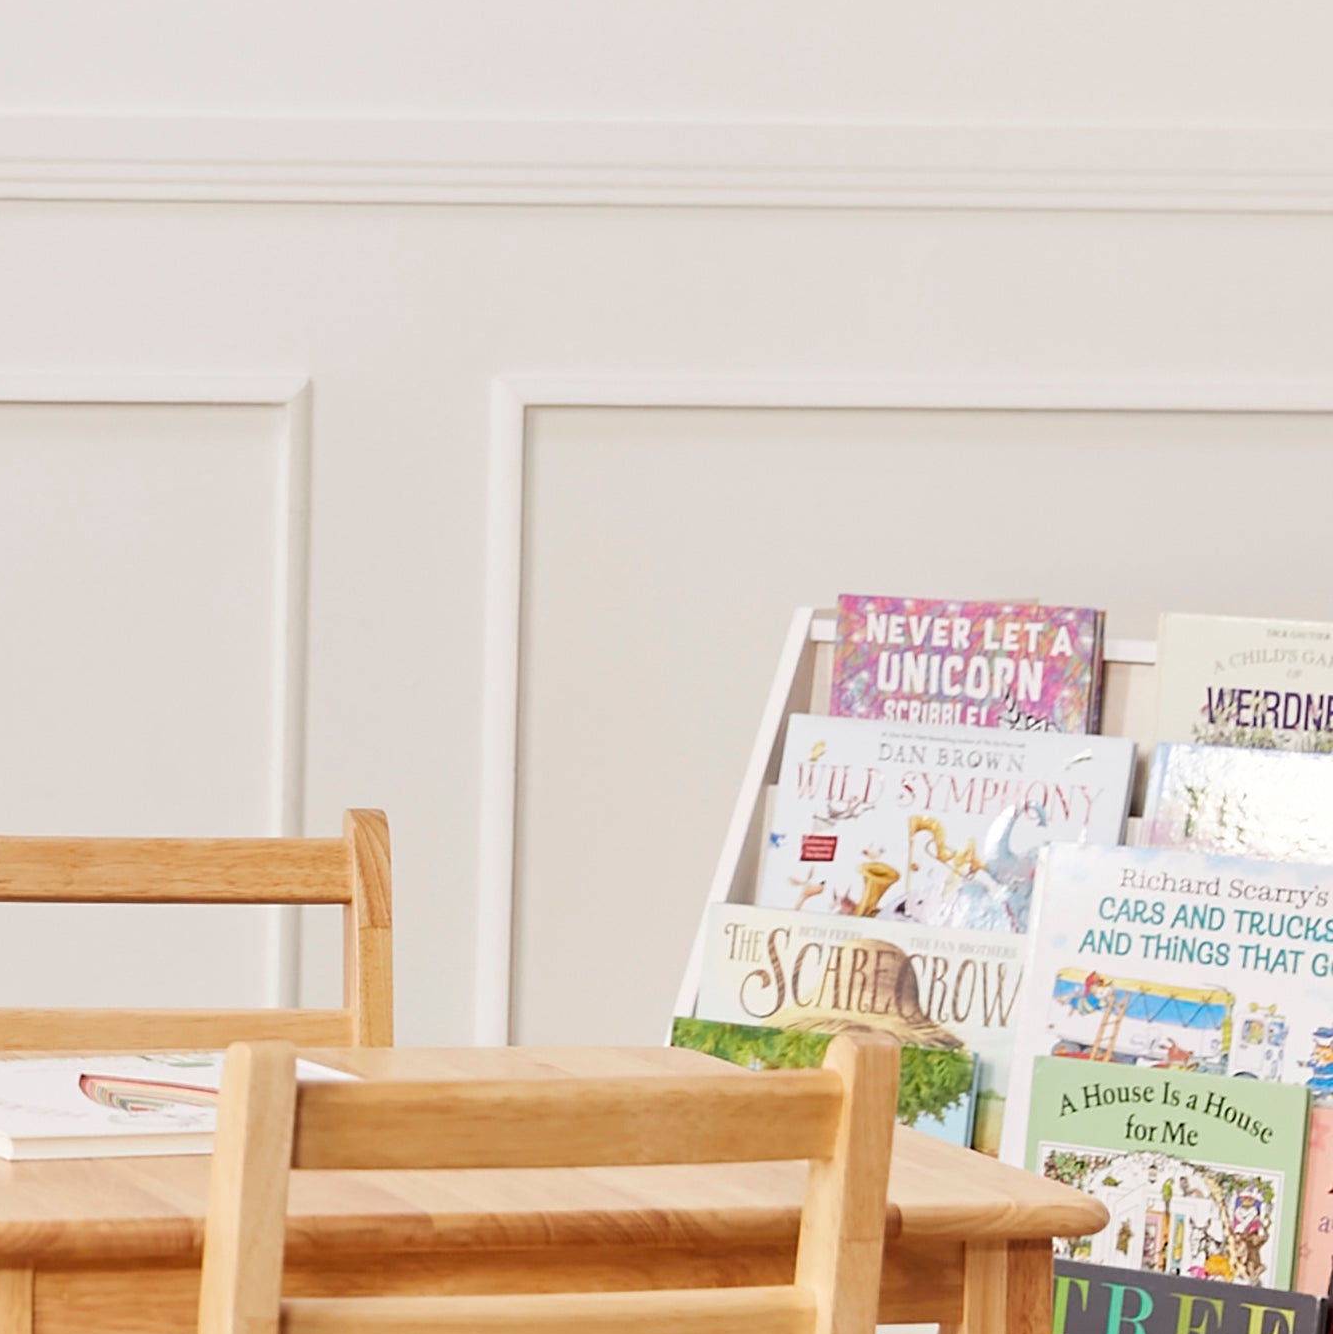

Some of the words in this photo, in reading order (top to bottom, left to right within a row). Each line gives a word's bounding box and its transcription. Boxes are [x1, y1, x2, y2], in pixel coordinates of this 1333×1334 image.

[867, 613, 971, 650] NEVER
[983, 617, 1045, 653] LET
[1050, 625, 1074, 657] A
[877, 650, 1044, 702] UNICORN
[878, 743, 927, 765] DAN
[936, 748, 1025, 772] BROWN
[796, 762, 885, 805] WILD
[897, 771, 1106, 825] SYMPHONY
[1119, 867, 1221, 898] Richard
[1228, 878, 1329, 911] Scarry's
[1099, 896, 1166, 926] CARS
[1170, 903, 1226, 932] AND
[724, 923, 766, 963] THE
[1079, 929, 1133, 957] AND
[1238, 944, 1305, 975] THAT
[739, 925, 1025, 1028] SCARECROW
[1058, 1093, 1078, 1117] A
[1082, 1083, 1155, 1109] House
[1162, 1082, 1180, 1107] Is
[1186, 1094, 1198, 1111] a
[1203, 1091, 1274, 1144] House
[1124, 1113, 1158, 1142] for
[1161, 1121, 1199, 1147] Me
